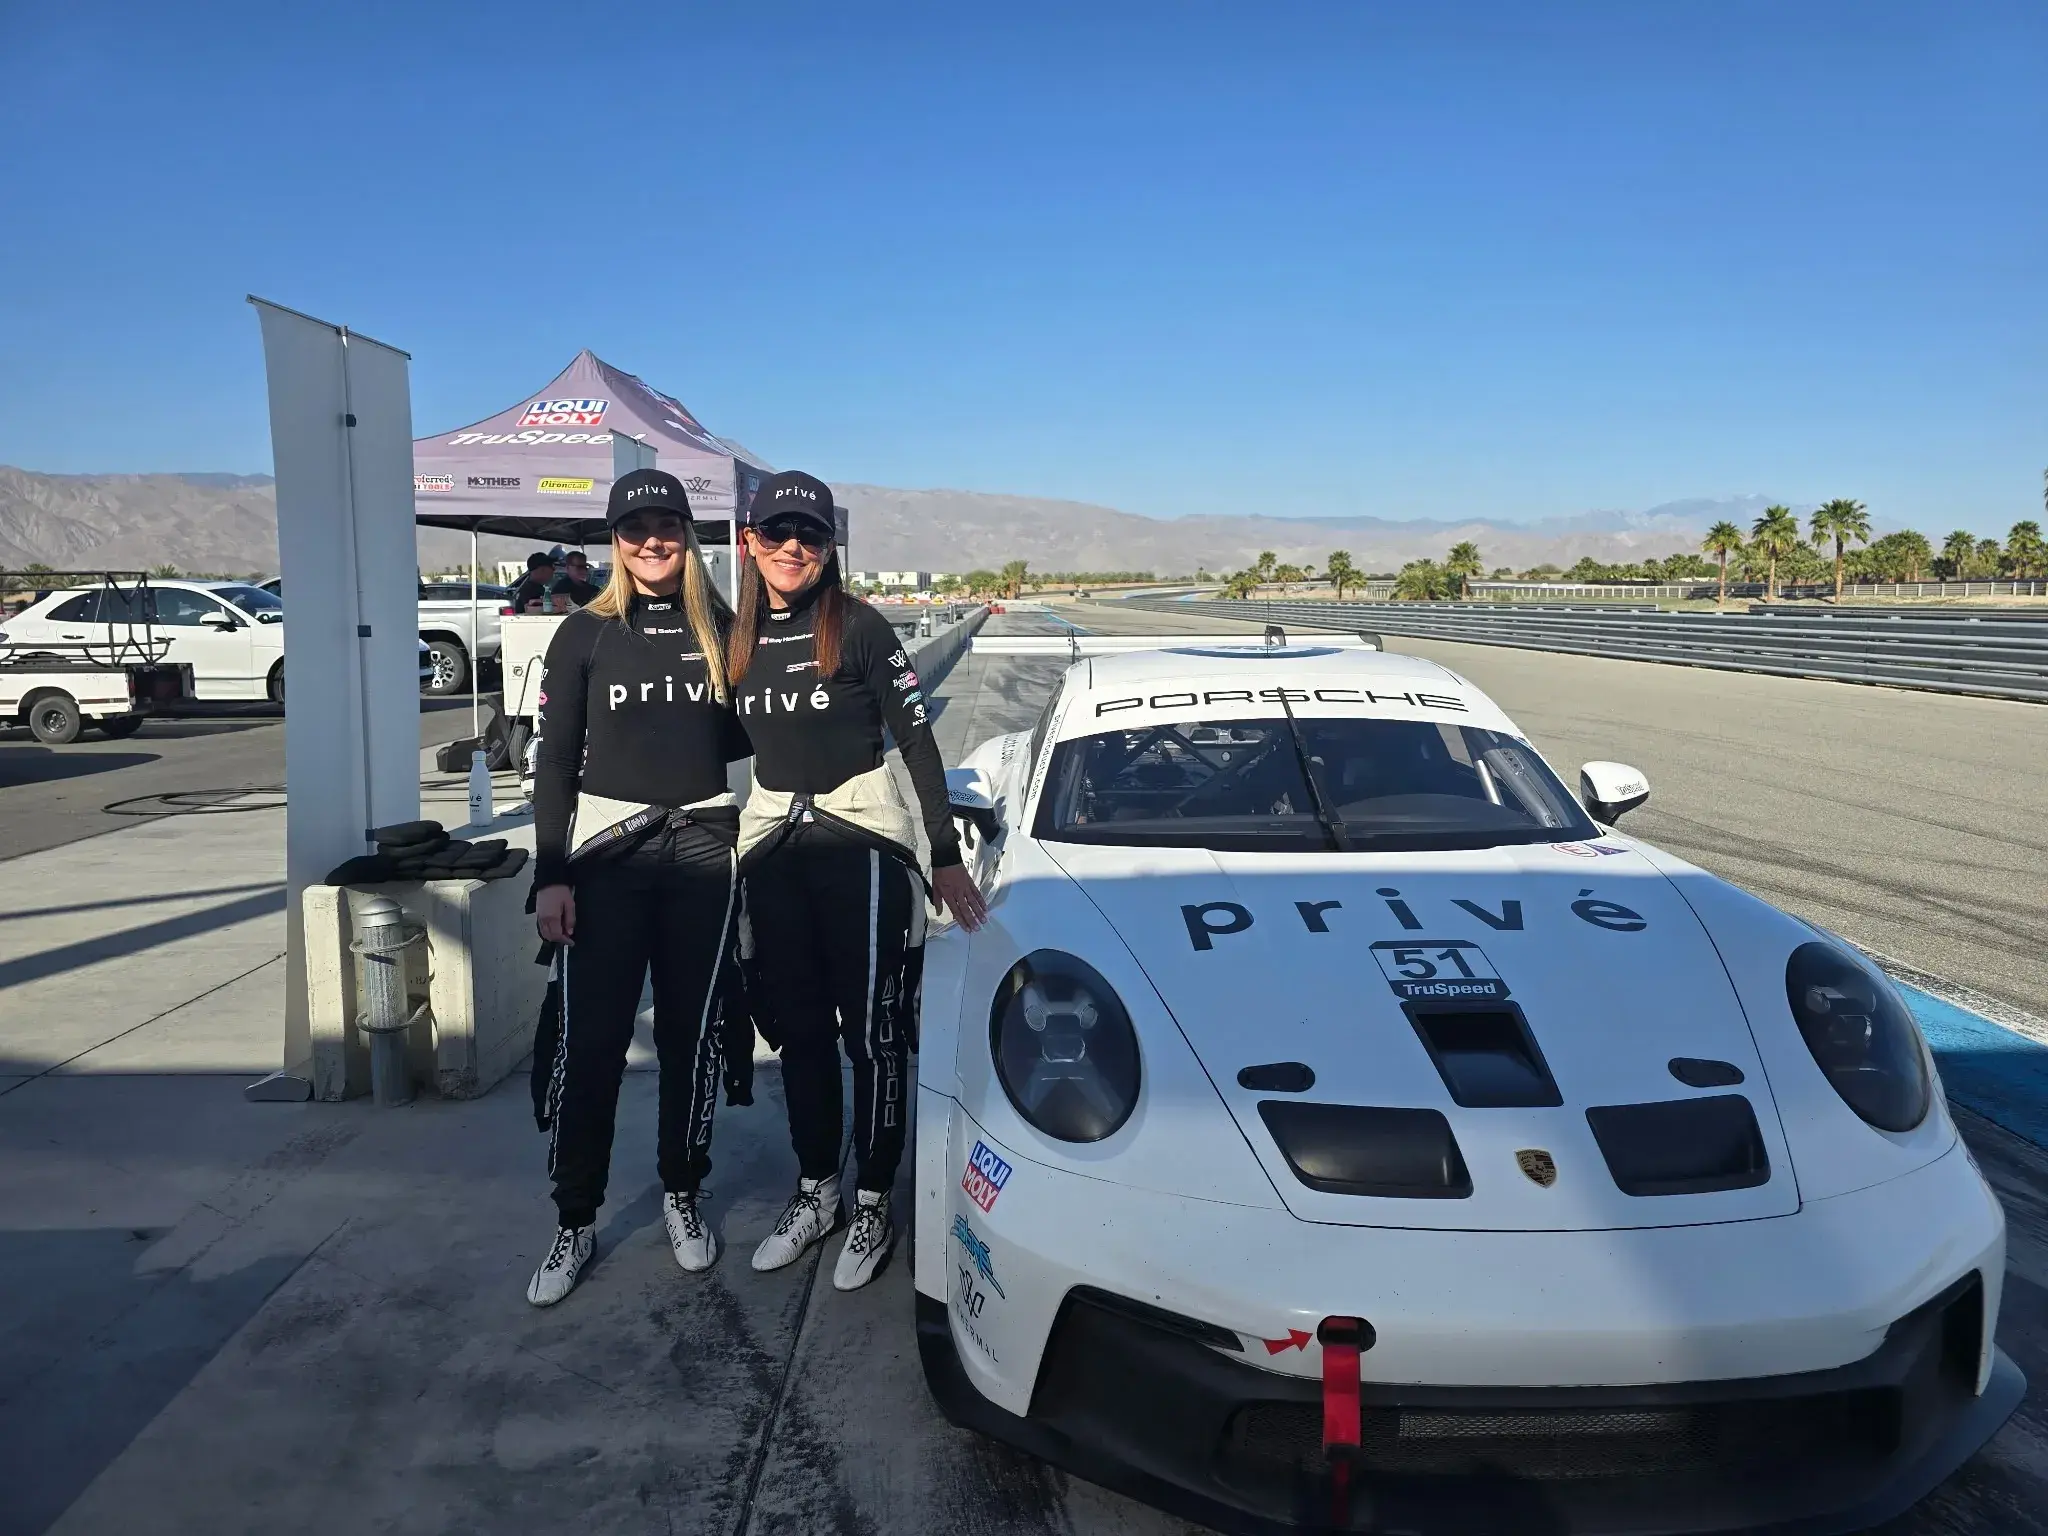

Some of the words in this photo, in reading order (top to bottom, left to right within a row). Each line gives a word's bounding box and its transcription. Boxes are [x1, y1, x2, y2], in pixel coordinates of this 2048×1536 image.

[529, 400, 605, 414] LIQUI
[522, 413, 602, 425] MOLY
[467, 477, 520, 486] MOTHERS
[627, 484, 668, 500] privé
[775, 487, 817, 500] privé
[1095, 688, 1469, 717] PORSCHE
[948, 790, 977, 803] Speed
[1180, 887, 1648, 951] privé
[1392, 948, 1476, 979] 51
[1402, 981, 1497, 998] TruSpeed
[972, 1145, 1009, 1188] LIQUI
[963, 1164, 998, 1209] MOLY
[791, 1221, 814, 1247] priv
[955, 1300, 999, 1363] THERMAL
